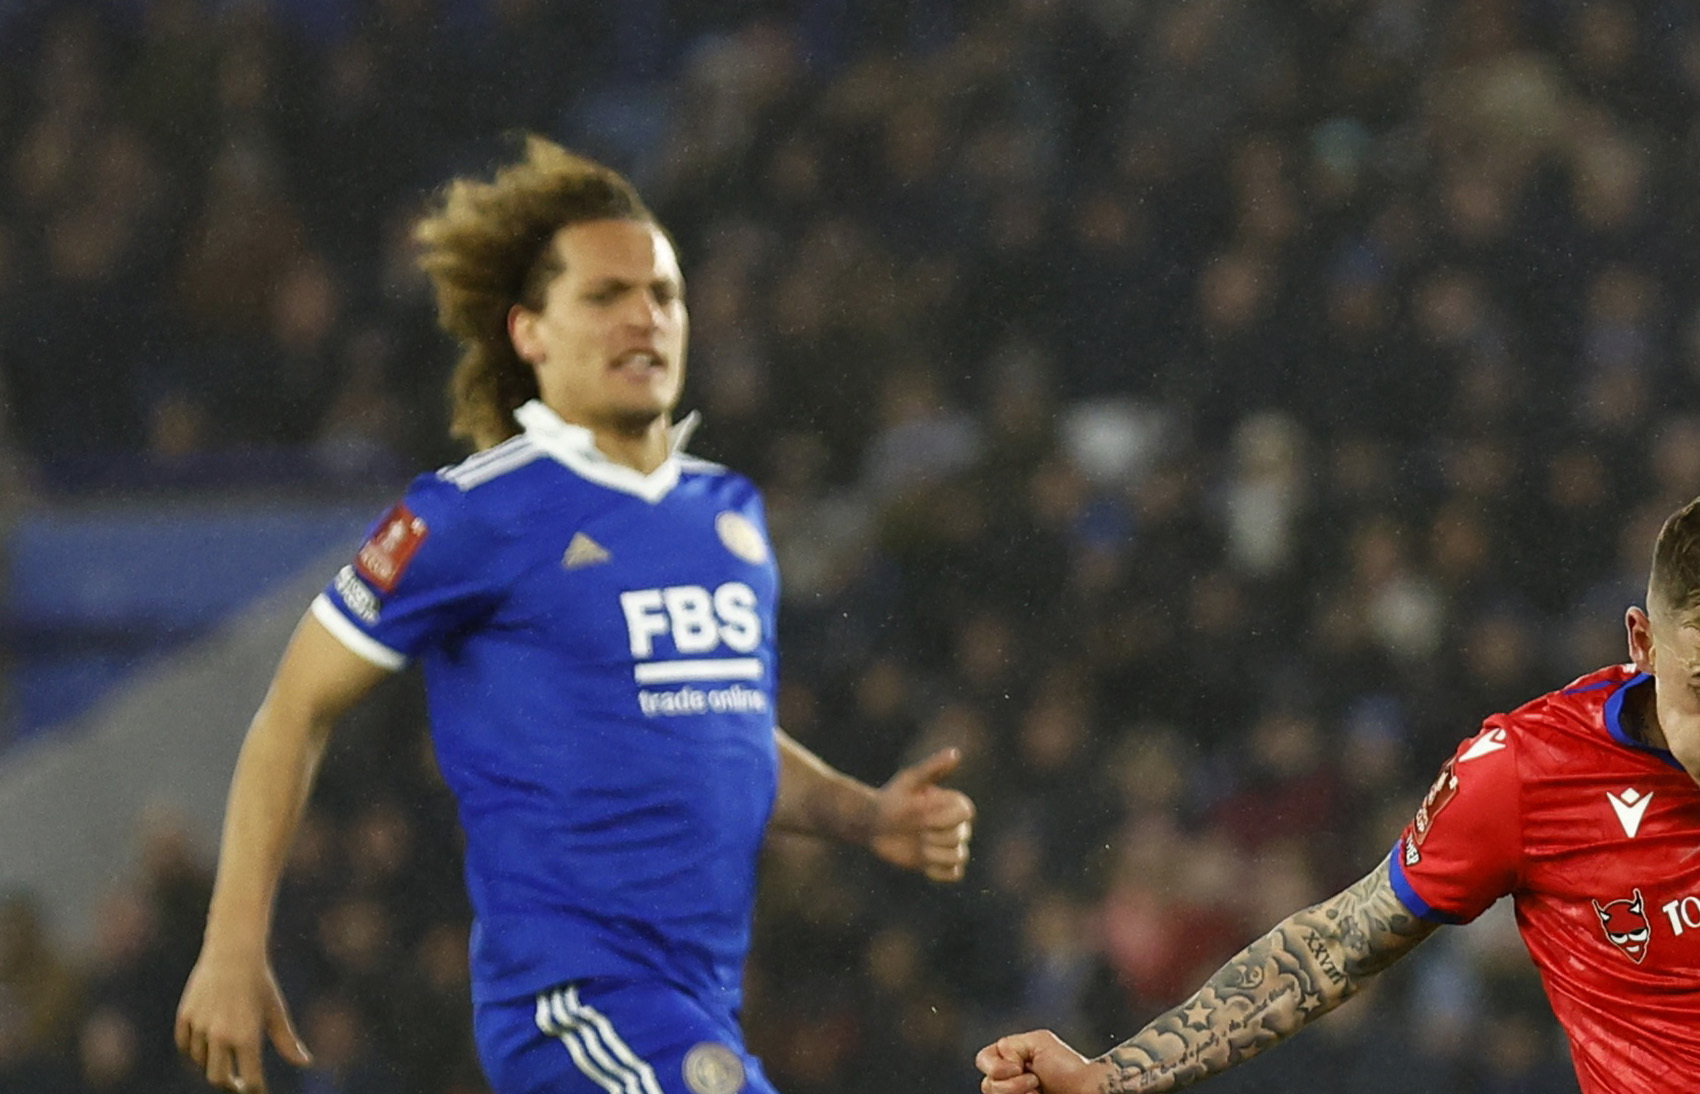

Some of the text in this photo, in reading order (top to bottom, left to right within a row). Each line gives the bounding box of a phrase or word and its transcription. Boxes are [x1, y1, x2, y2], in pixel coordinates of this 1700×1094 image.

[620, 581, 761, 659] FBS
[638, 684, 768, 717] trade online
